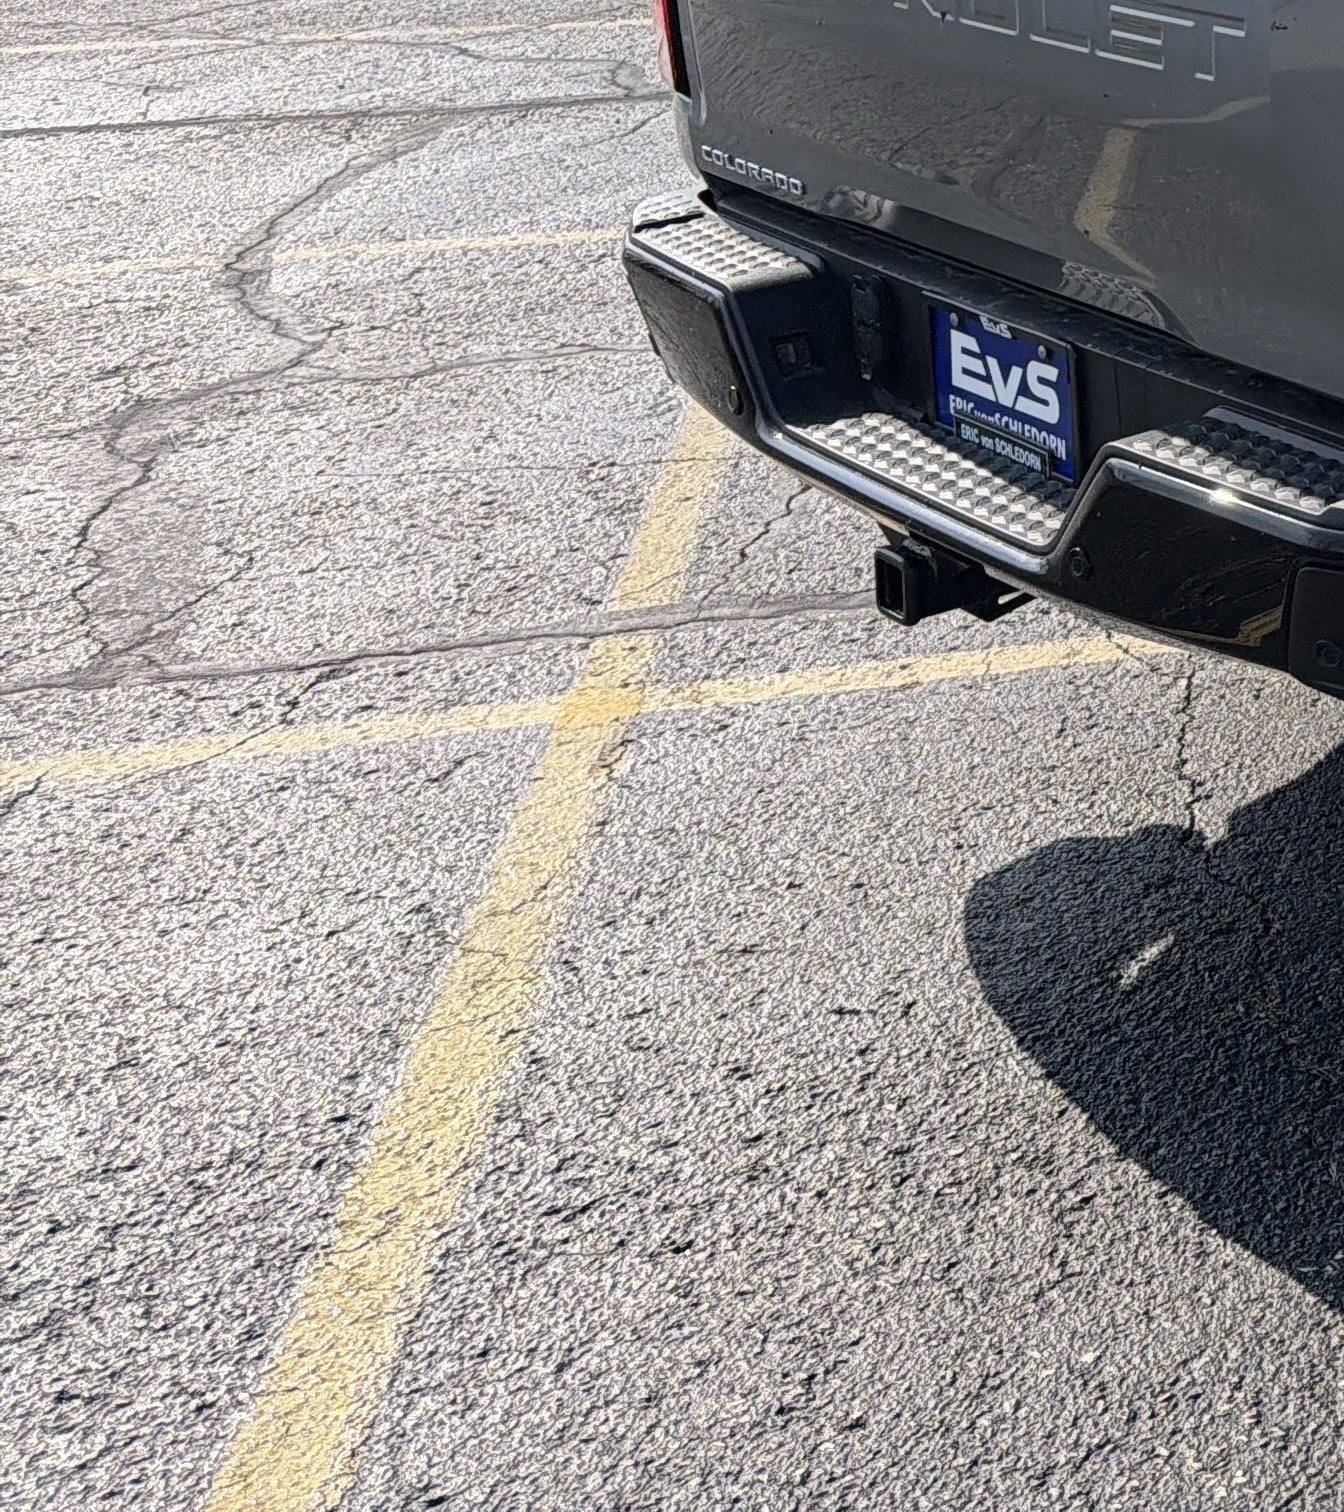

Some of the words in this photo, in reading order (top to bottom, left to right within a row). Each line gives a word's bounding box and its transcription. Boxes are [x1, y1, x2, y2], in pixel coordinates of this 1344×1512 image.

[701, 144, 805, 196] COLORADO
[961, 423, 980, 444] ERIC
[994, 437, 1042, 473] SCHLEDORN
